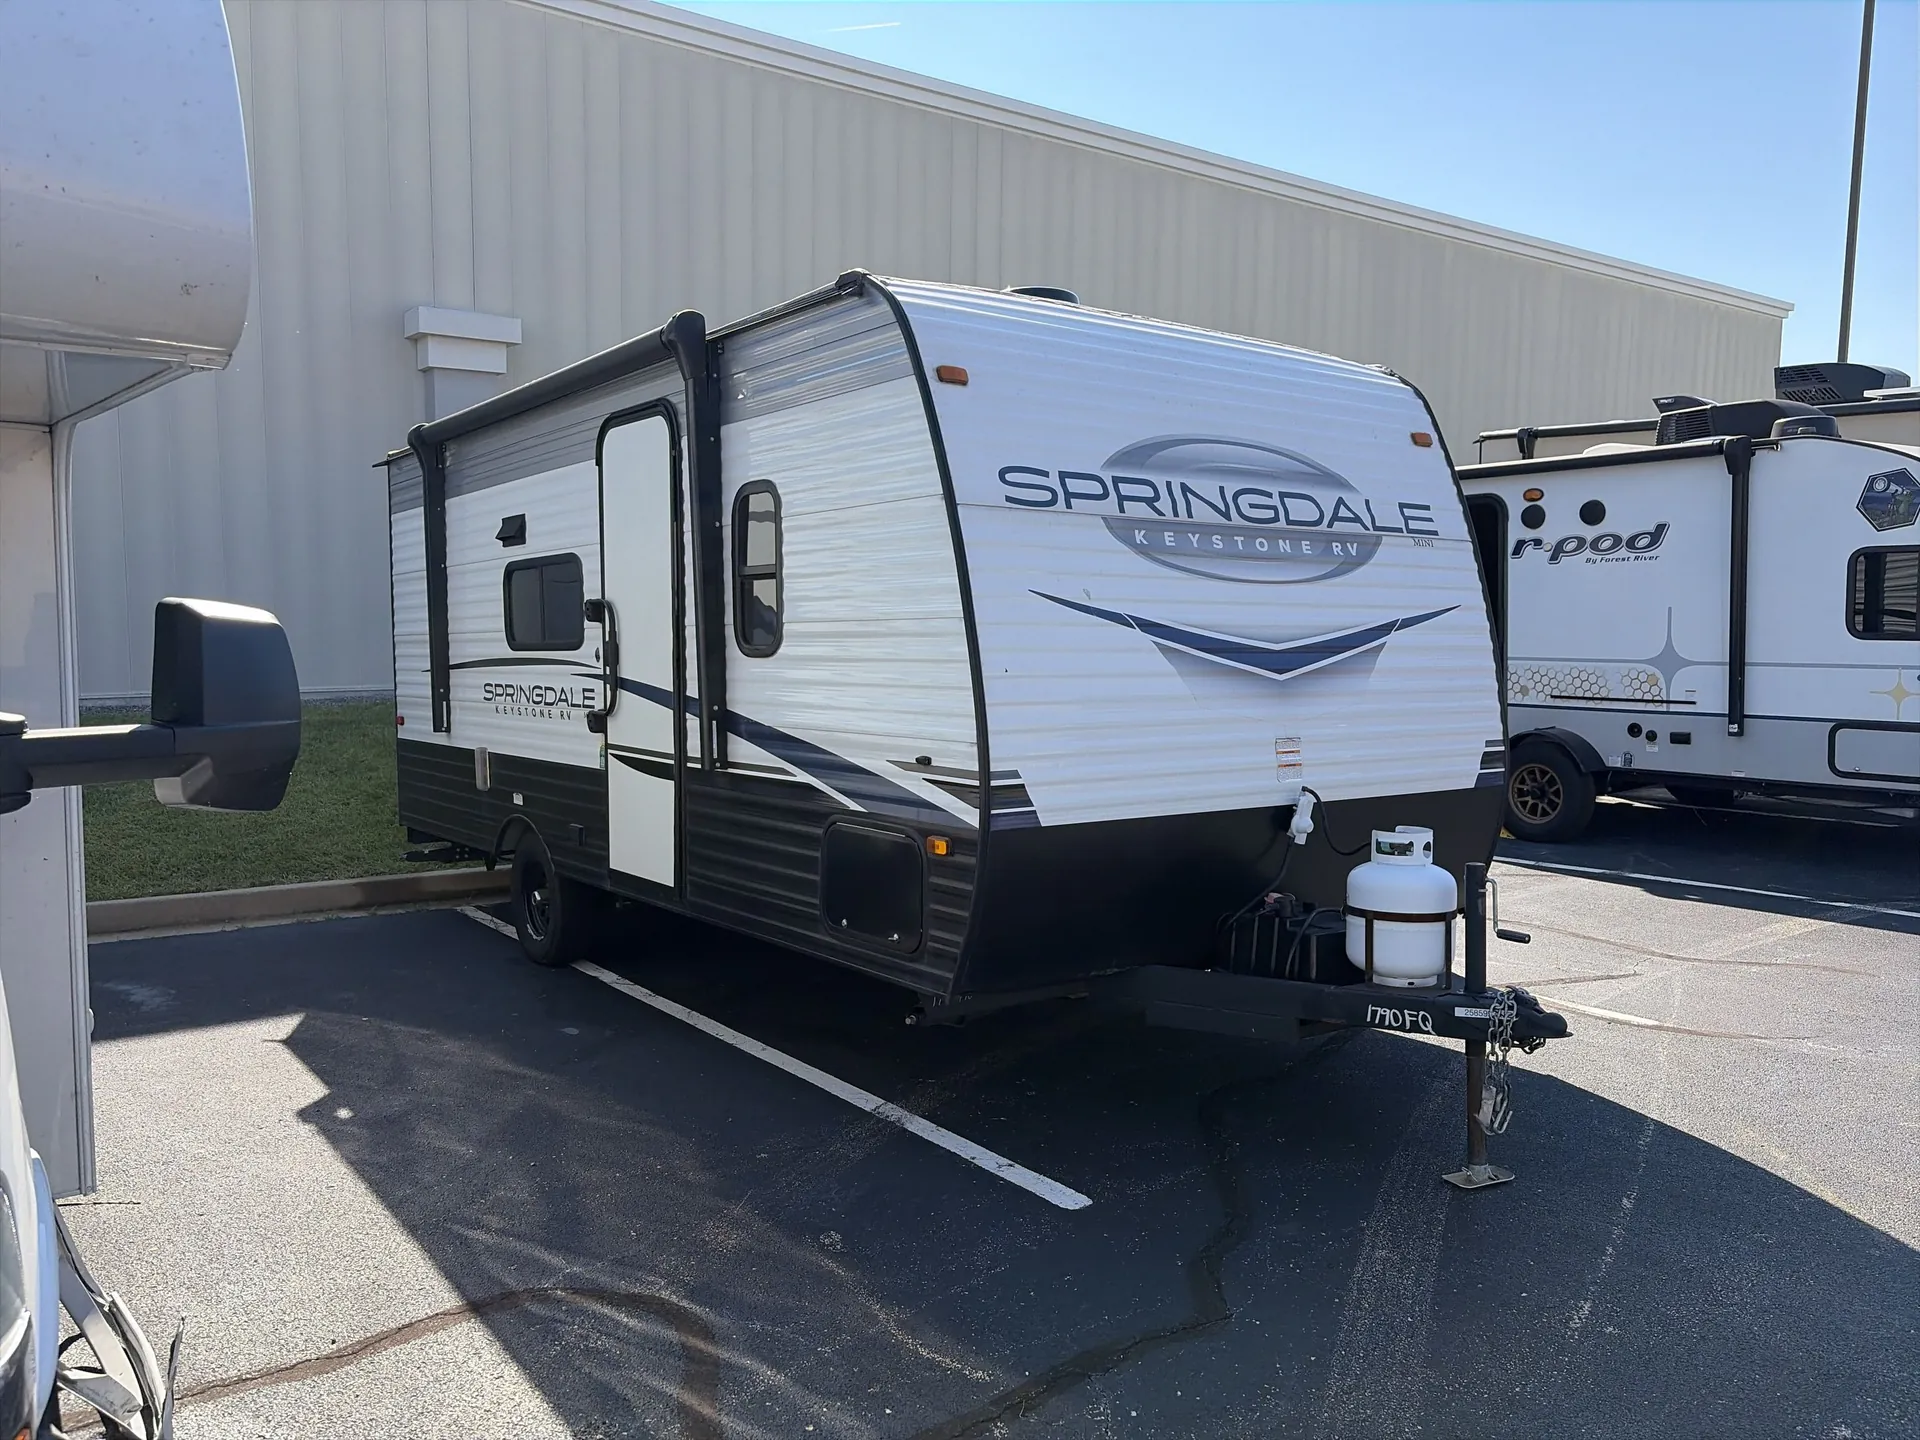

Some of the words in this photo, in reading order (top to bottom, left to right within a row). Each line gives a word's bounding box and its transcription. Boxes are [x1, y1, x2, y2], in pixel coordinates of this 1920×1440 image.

[998, 465, 1440, 537] SPRINGDALE
[1134, 529, 1313, 555] KEYSTONE
[1332, 542, 1358, 556] RV
[1412, 538, 1434, 548] MINI
[1585, 557, 1598, 565] By
[1633, 554, 1660, 562] River
[483, 682, 596, 709] SPRINGDALE
[495, 705, 553, 719] KEYSTONE
[560, 710, 572, 721] RV
